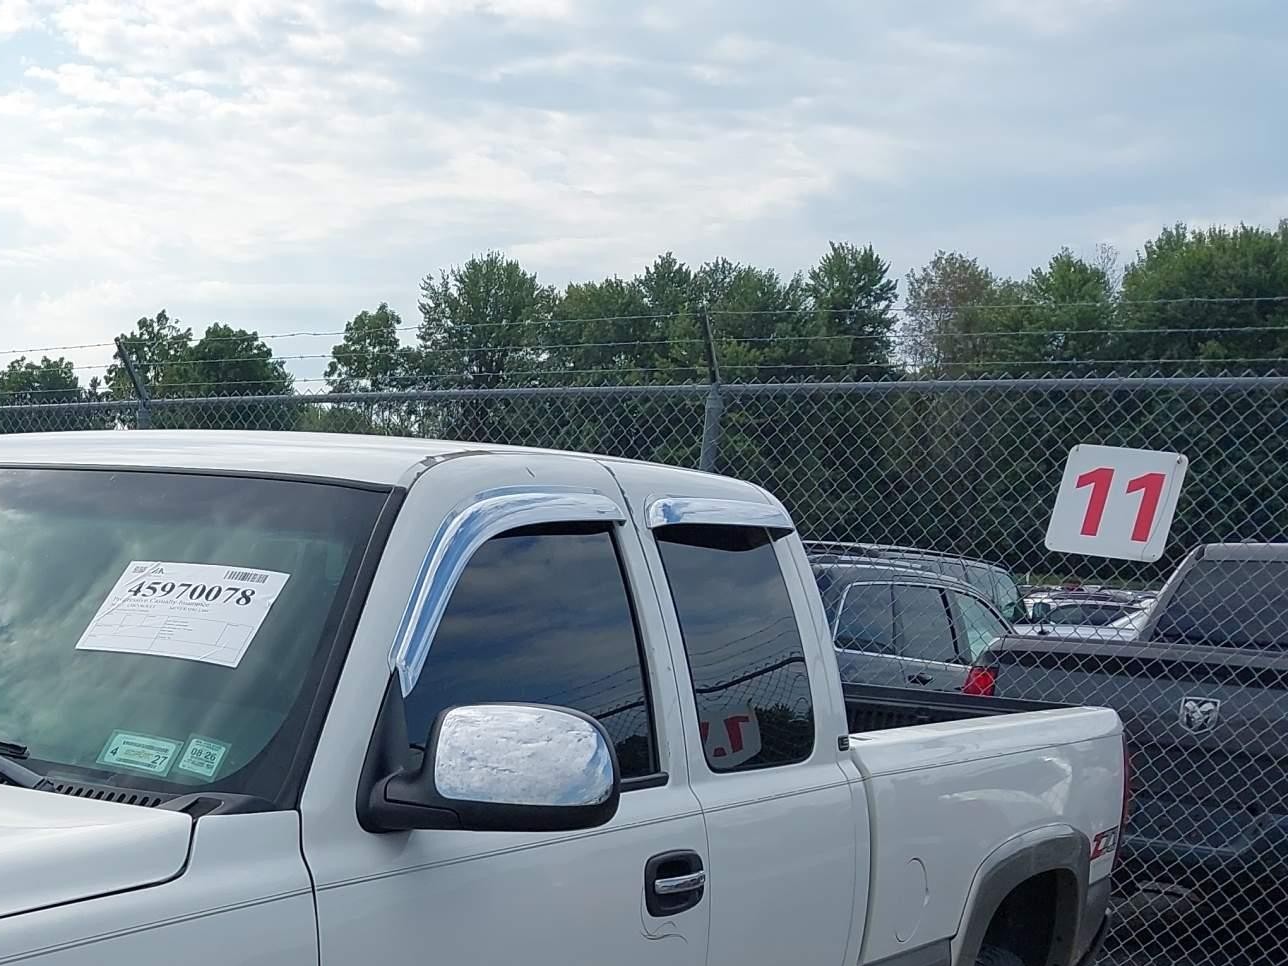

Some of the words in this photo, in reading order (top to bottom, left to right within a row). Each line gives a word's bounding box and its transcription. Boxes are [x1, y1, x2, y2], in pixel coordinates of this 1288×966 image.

[1075, 467, 1167, 543] 11
[128, 580, 256, 606] 45970078
[110, 746, 119, 757] 4
[151, 754, 168, 766] 27
